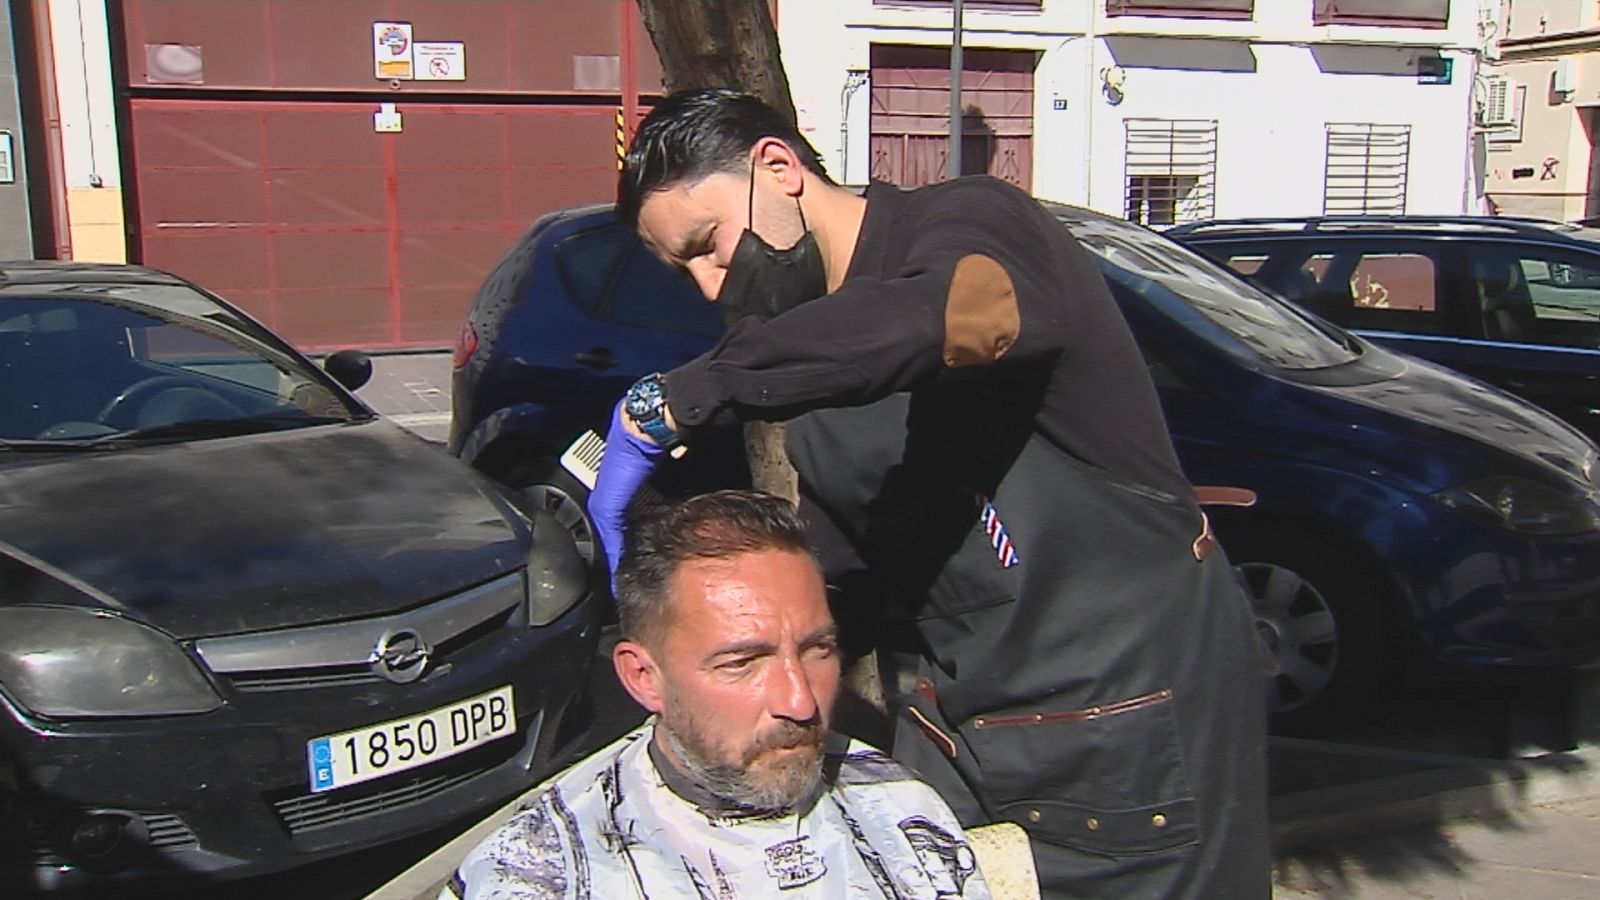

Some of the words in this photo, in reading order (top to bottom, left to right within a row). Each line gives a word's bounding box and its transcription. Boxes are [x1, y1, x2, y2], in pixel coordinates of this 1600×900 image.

[345, 719, 437, 775] 1850
[450, 696, 507, 747] DPB
[318, 768, 330, 782] E
